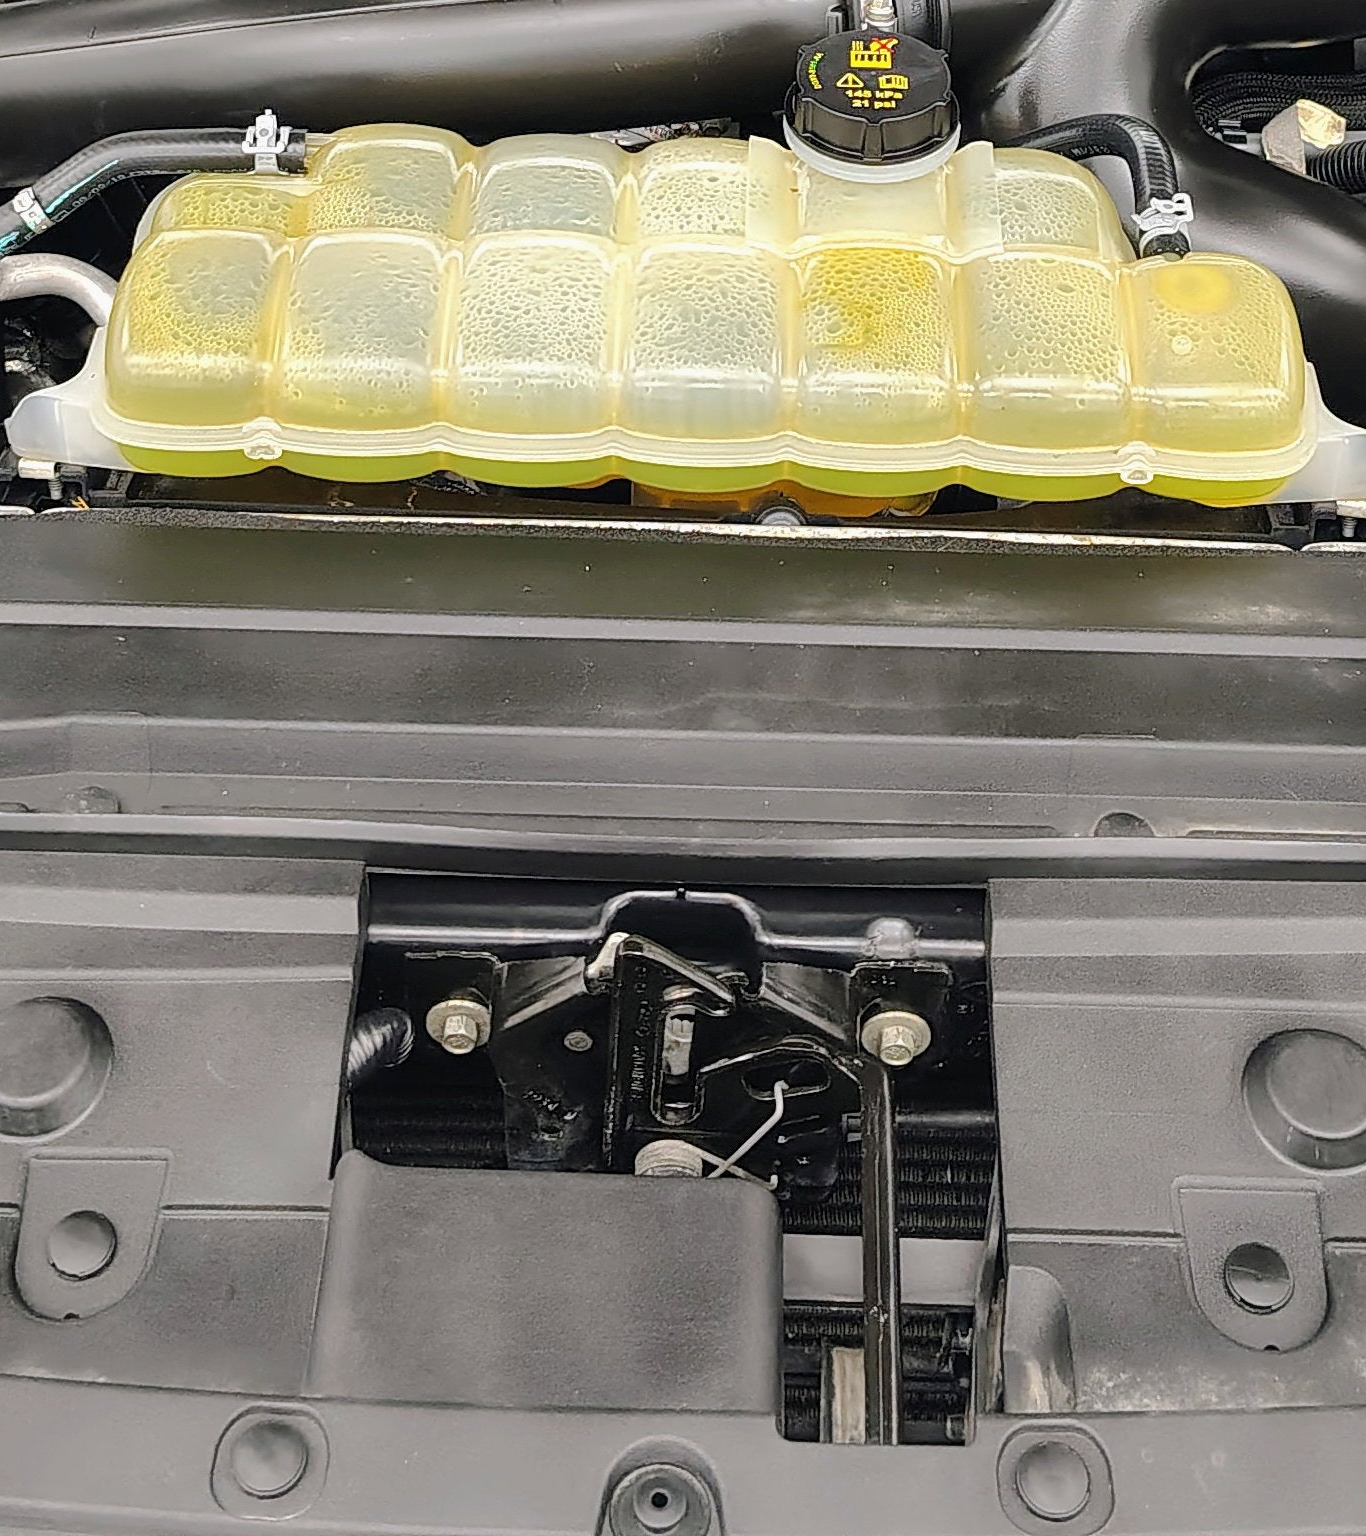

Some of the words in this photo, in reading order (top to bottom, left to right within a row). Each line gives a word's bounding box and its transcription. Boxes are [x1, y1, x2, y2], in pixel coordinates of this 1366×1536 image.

[845, 89, 873, 98] 145
[875, 90, 904, 100] kPa
[851, 99, 870, 108] 21
[873, 100, 897, 110] psi
